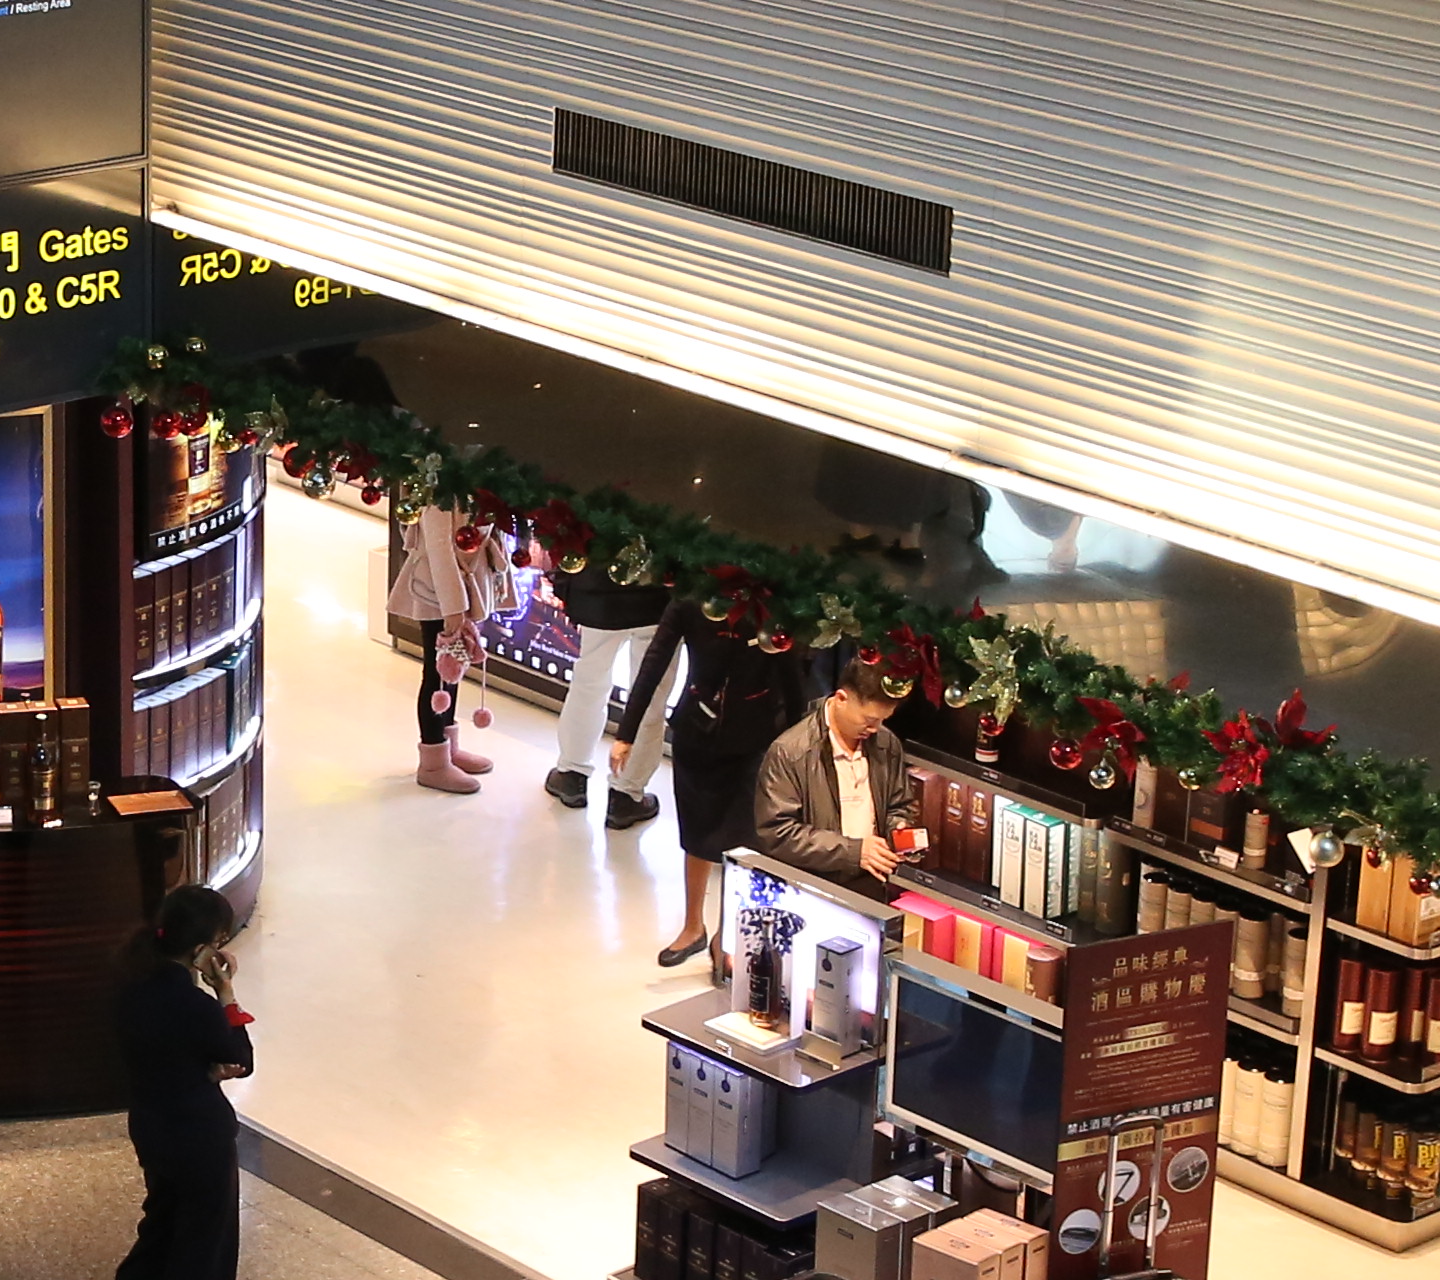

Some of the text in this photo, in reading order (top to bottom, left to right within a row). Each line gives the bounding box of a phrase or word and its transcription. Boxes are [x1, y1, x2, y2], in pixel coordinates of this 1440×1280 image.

[16, 1, 48, 15] Resting
[39, 225, 129, 263] Gates
[24, 286, 47, 316] &
[56, 270, 122, 308] C5R
[1112, 947, 1189, 978] 品味經典
[1091, 972, 1207, 1013] 酒區購物慶
